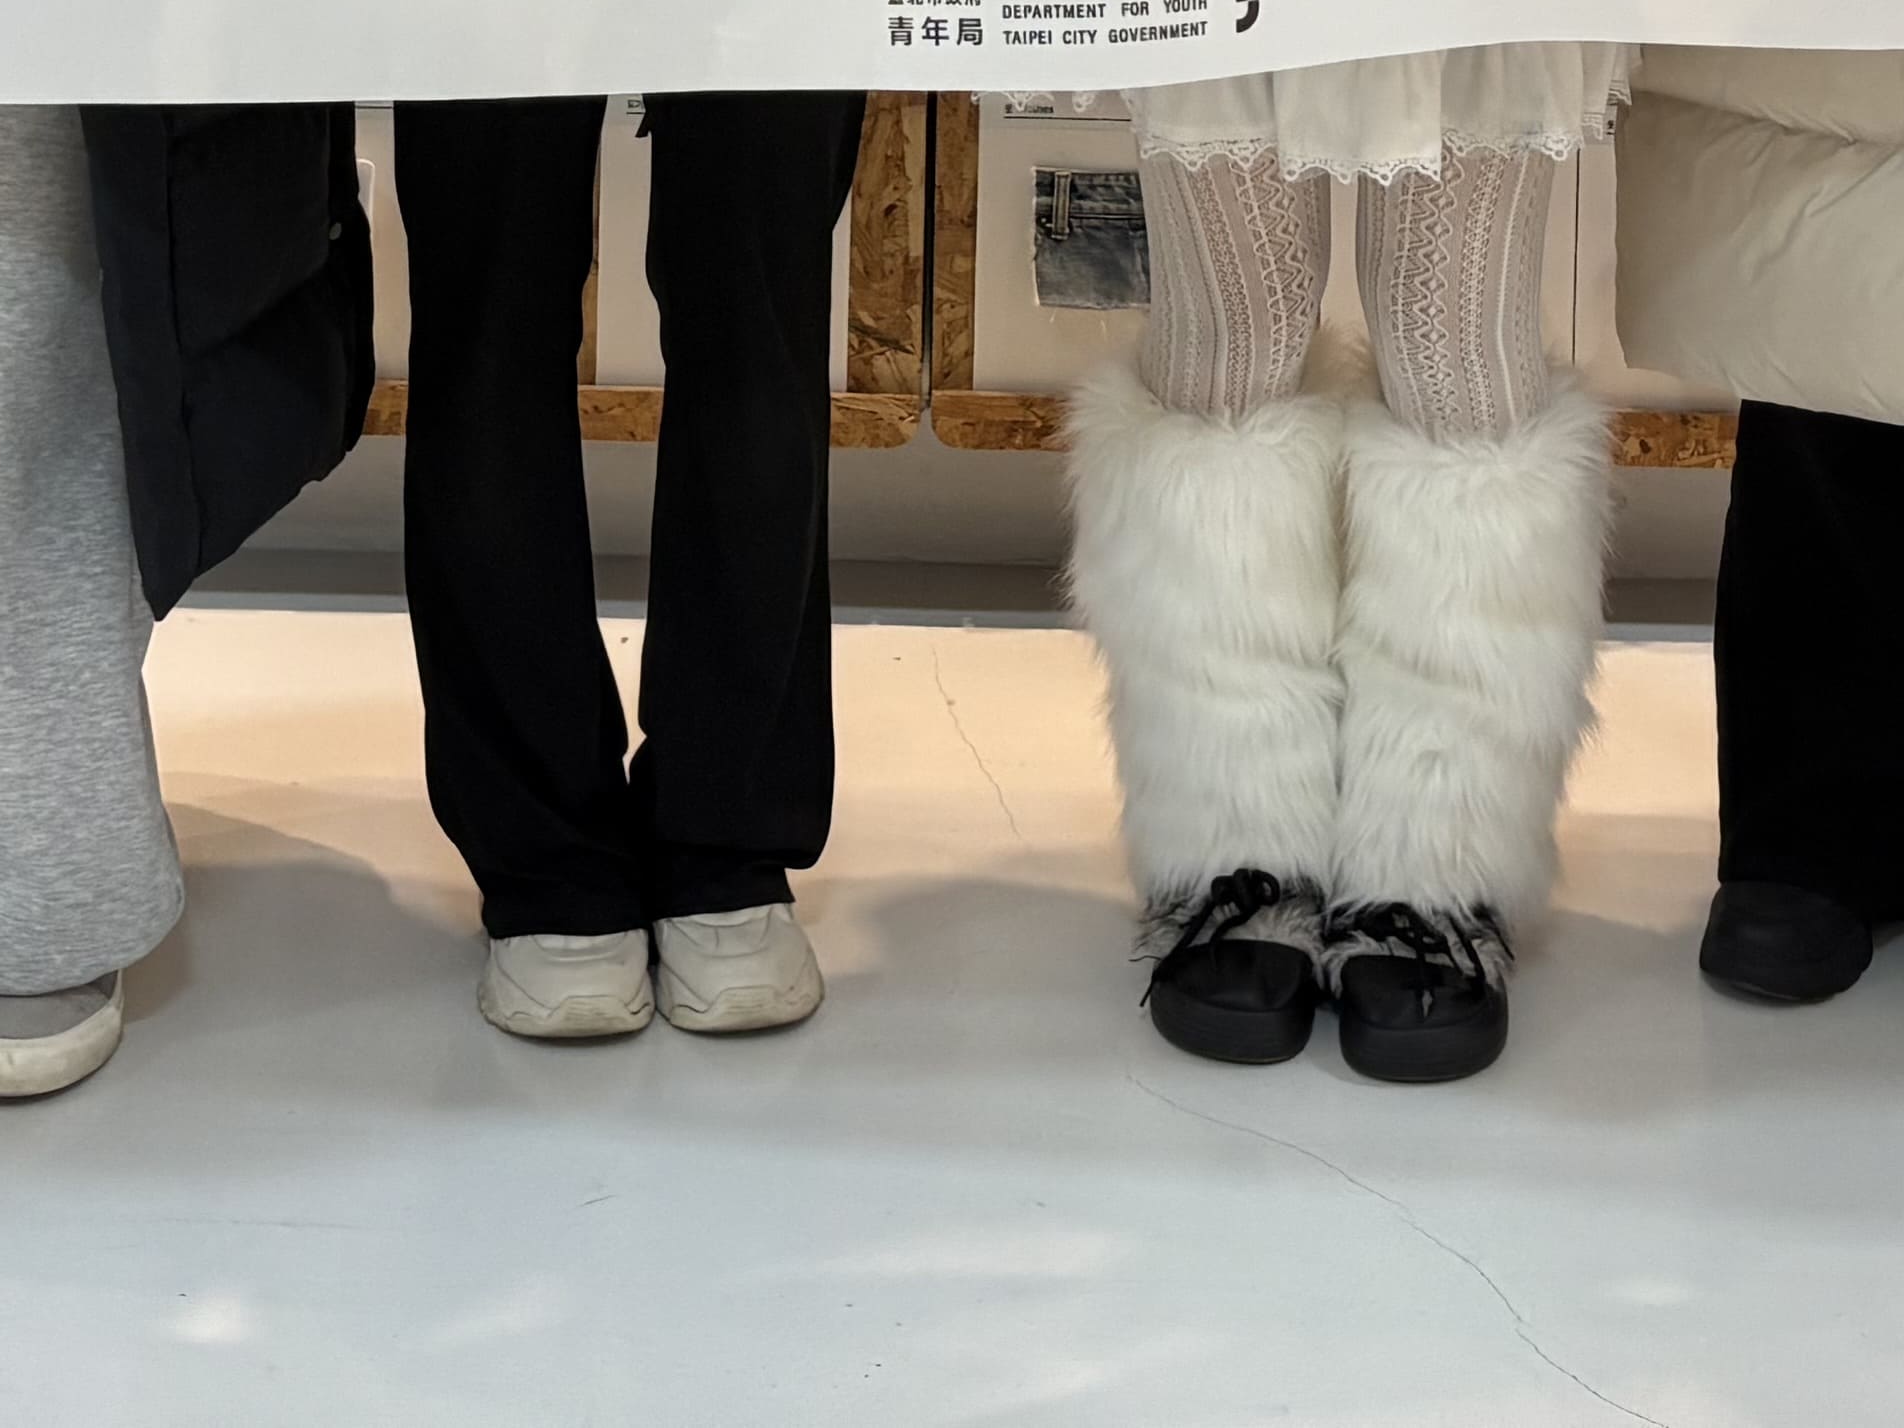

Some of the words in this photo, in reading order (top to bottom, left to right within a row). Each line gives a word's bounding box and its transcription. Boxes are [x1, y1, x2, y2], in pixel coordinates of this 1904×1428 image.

[1003, 4, 1106, 19] DEPARTMENT
[1122, 1, 1149, 16] FOR
[888, 16, 983, 46] 青年局
[1003, 30, 1052, 44] TAIPEI
[1063, 30, 1097, 44] CITY
[1109, 21, 1207, 43] GOVERNMENT
